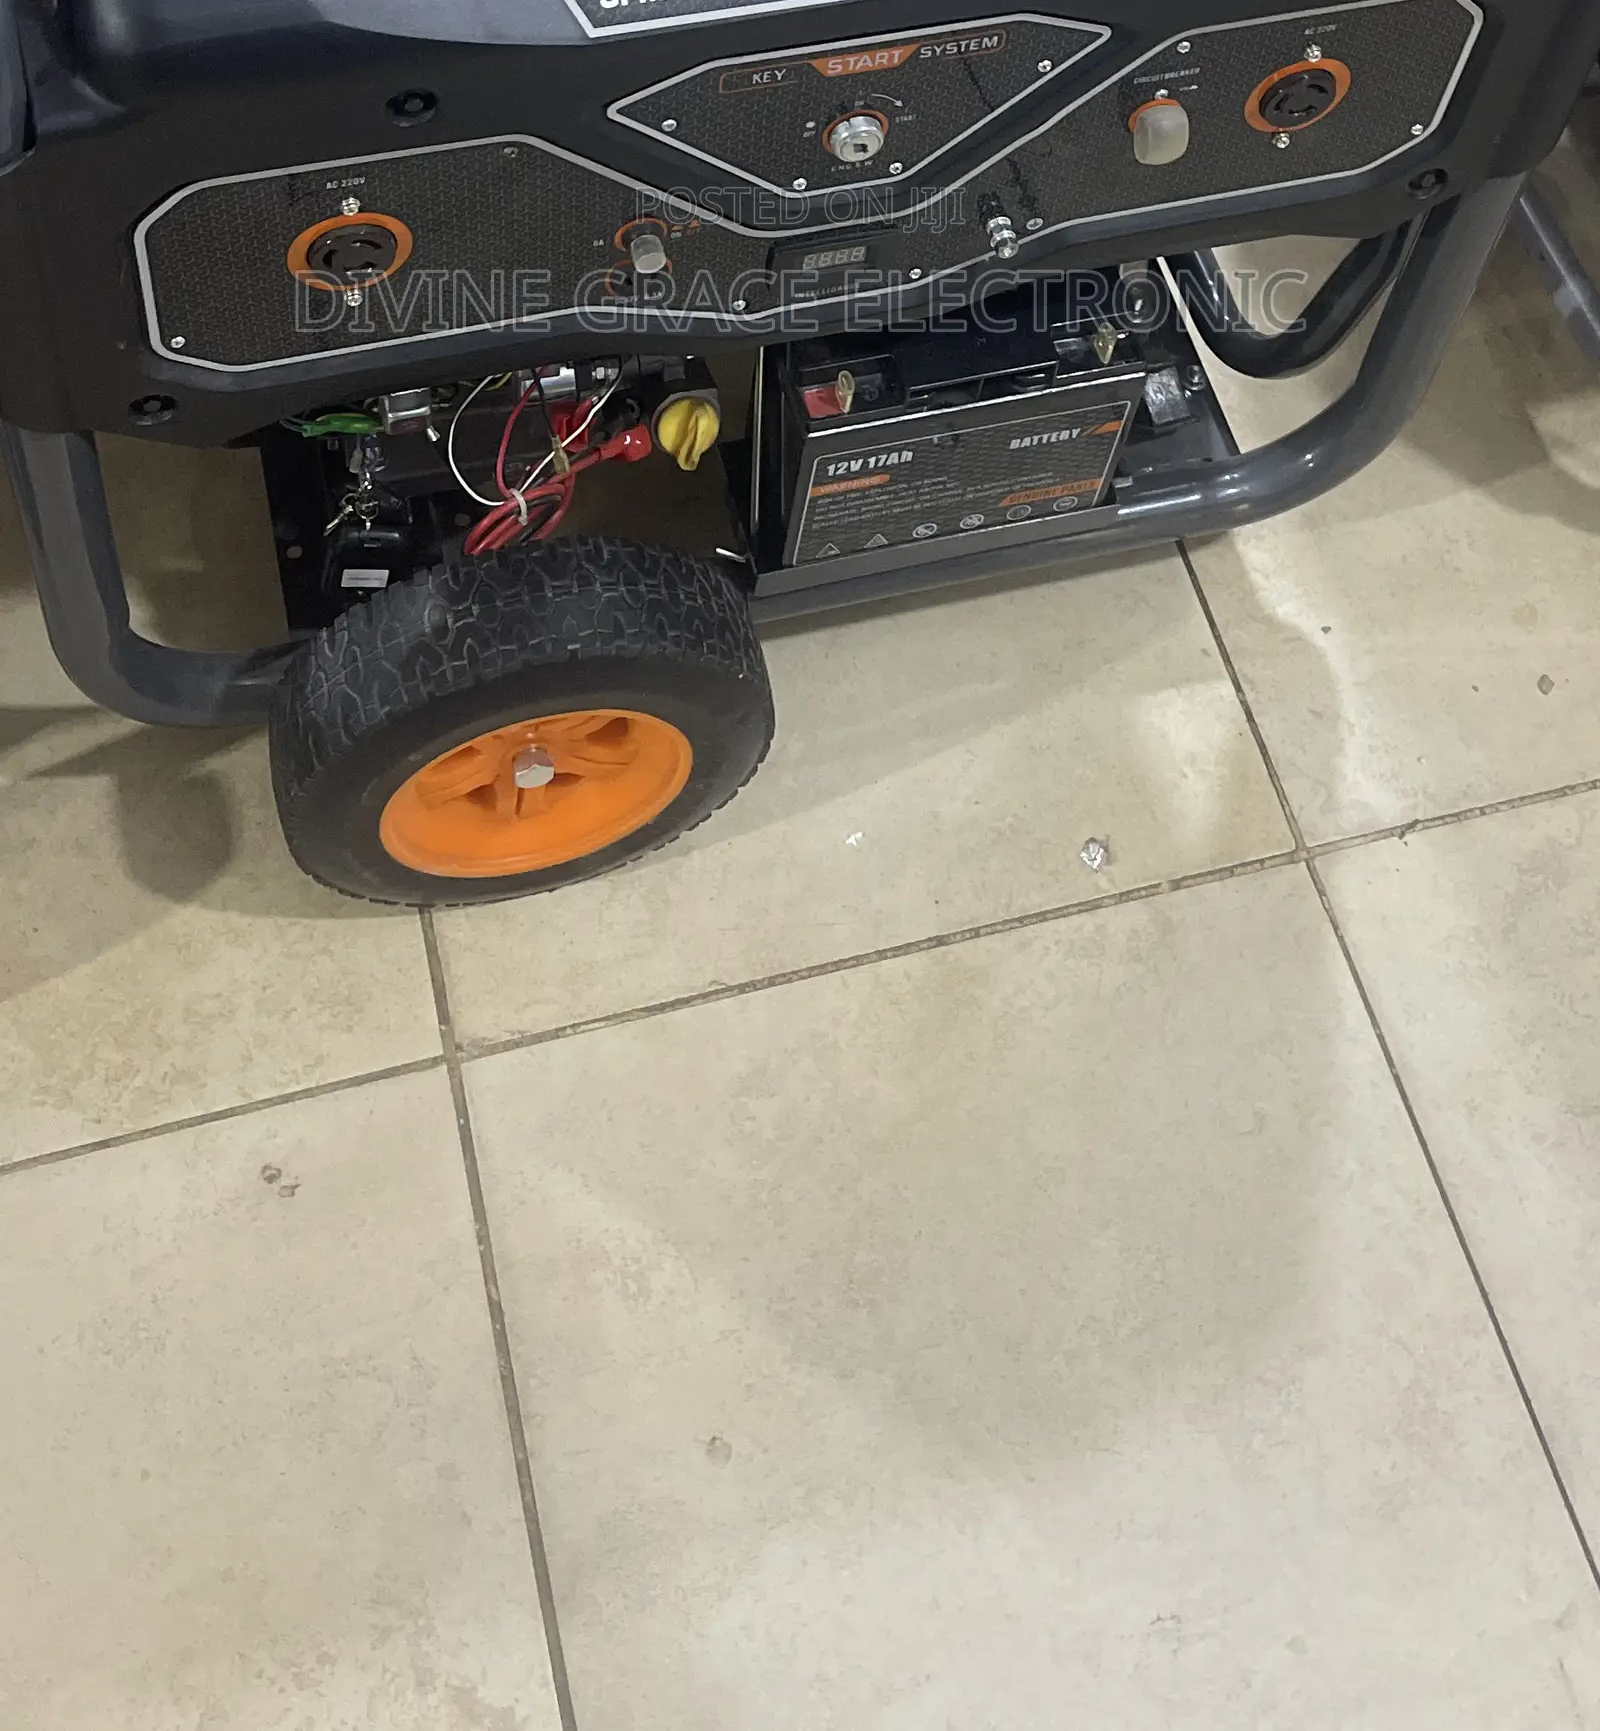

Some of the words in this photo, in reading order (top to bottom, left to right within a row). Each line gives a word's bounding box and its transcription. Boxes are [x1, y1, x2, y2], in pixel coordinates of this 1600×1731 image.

[752, 68, 787, 85] KEY
[827, 49, 905, 75] START
[919, 35, 999, 59] SYSTEM
[1009, 427, 1082, 450] BATTERY
[826, 459, 864, 477] 12V
[867, 449, 914, 469] 17Ah
